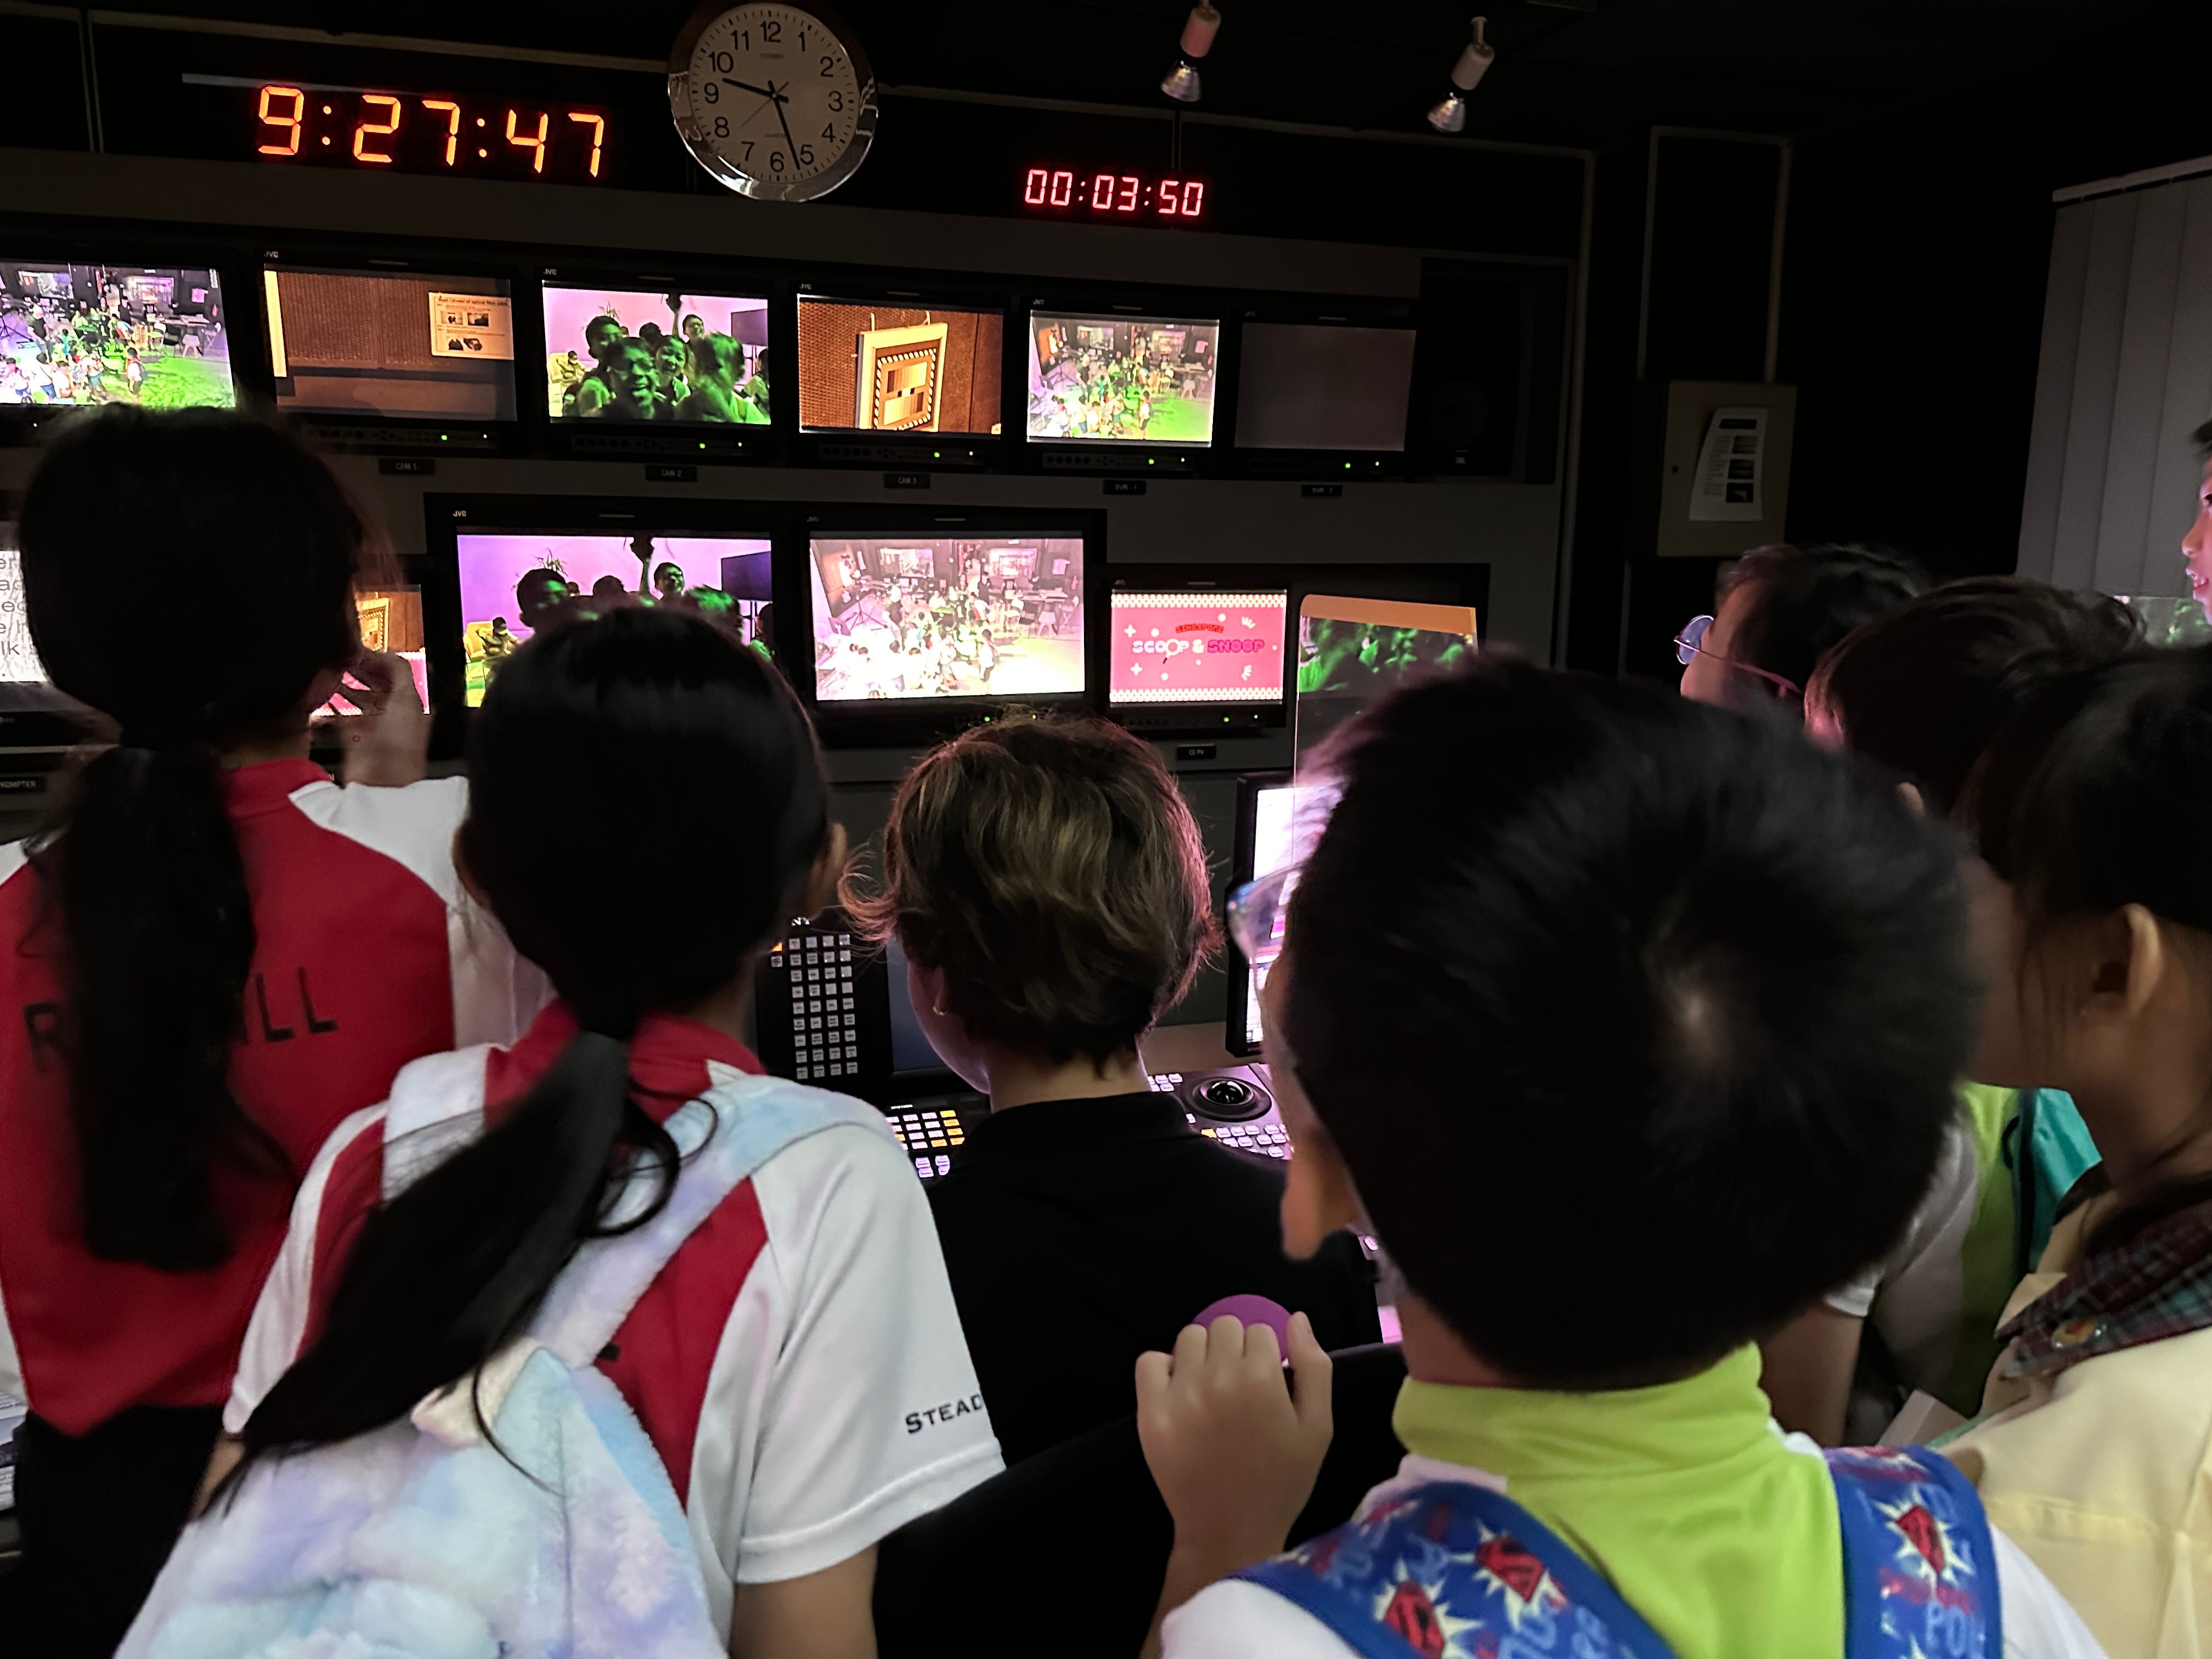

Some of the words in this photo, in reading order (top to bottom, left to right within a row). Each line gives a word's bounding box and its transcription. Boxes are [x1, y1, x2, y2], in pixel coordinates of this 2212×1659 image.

[731, 30, 749, 50] 11
[760, 21, 781, 43] 12
[798, 31, 805, 52] 1
[709, 52, 733, 73] 10
[820, 57, 833, 77] 2
[704, 83, 719, 104] 9
[828, 91, 843, 111] 3
[257, 85, 604, 177] 9:27:47
[714, 117, 730, 138] 8
[822, 123, 835, 143] 4
[741, 142, 754, 161] 7
[770, 151, 784, 172] 6
[800, 144, 814, 165] 5
[1025, 169, 1203, 216] 00:03:50
[1192, 639, 1205, 653] &
[1207, 639, 1265, 653] SNOOP
